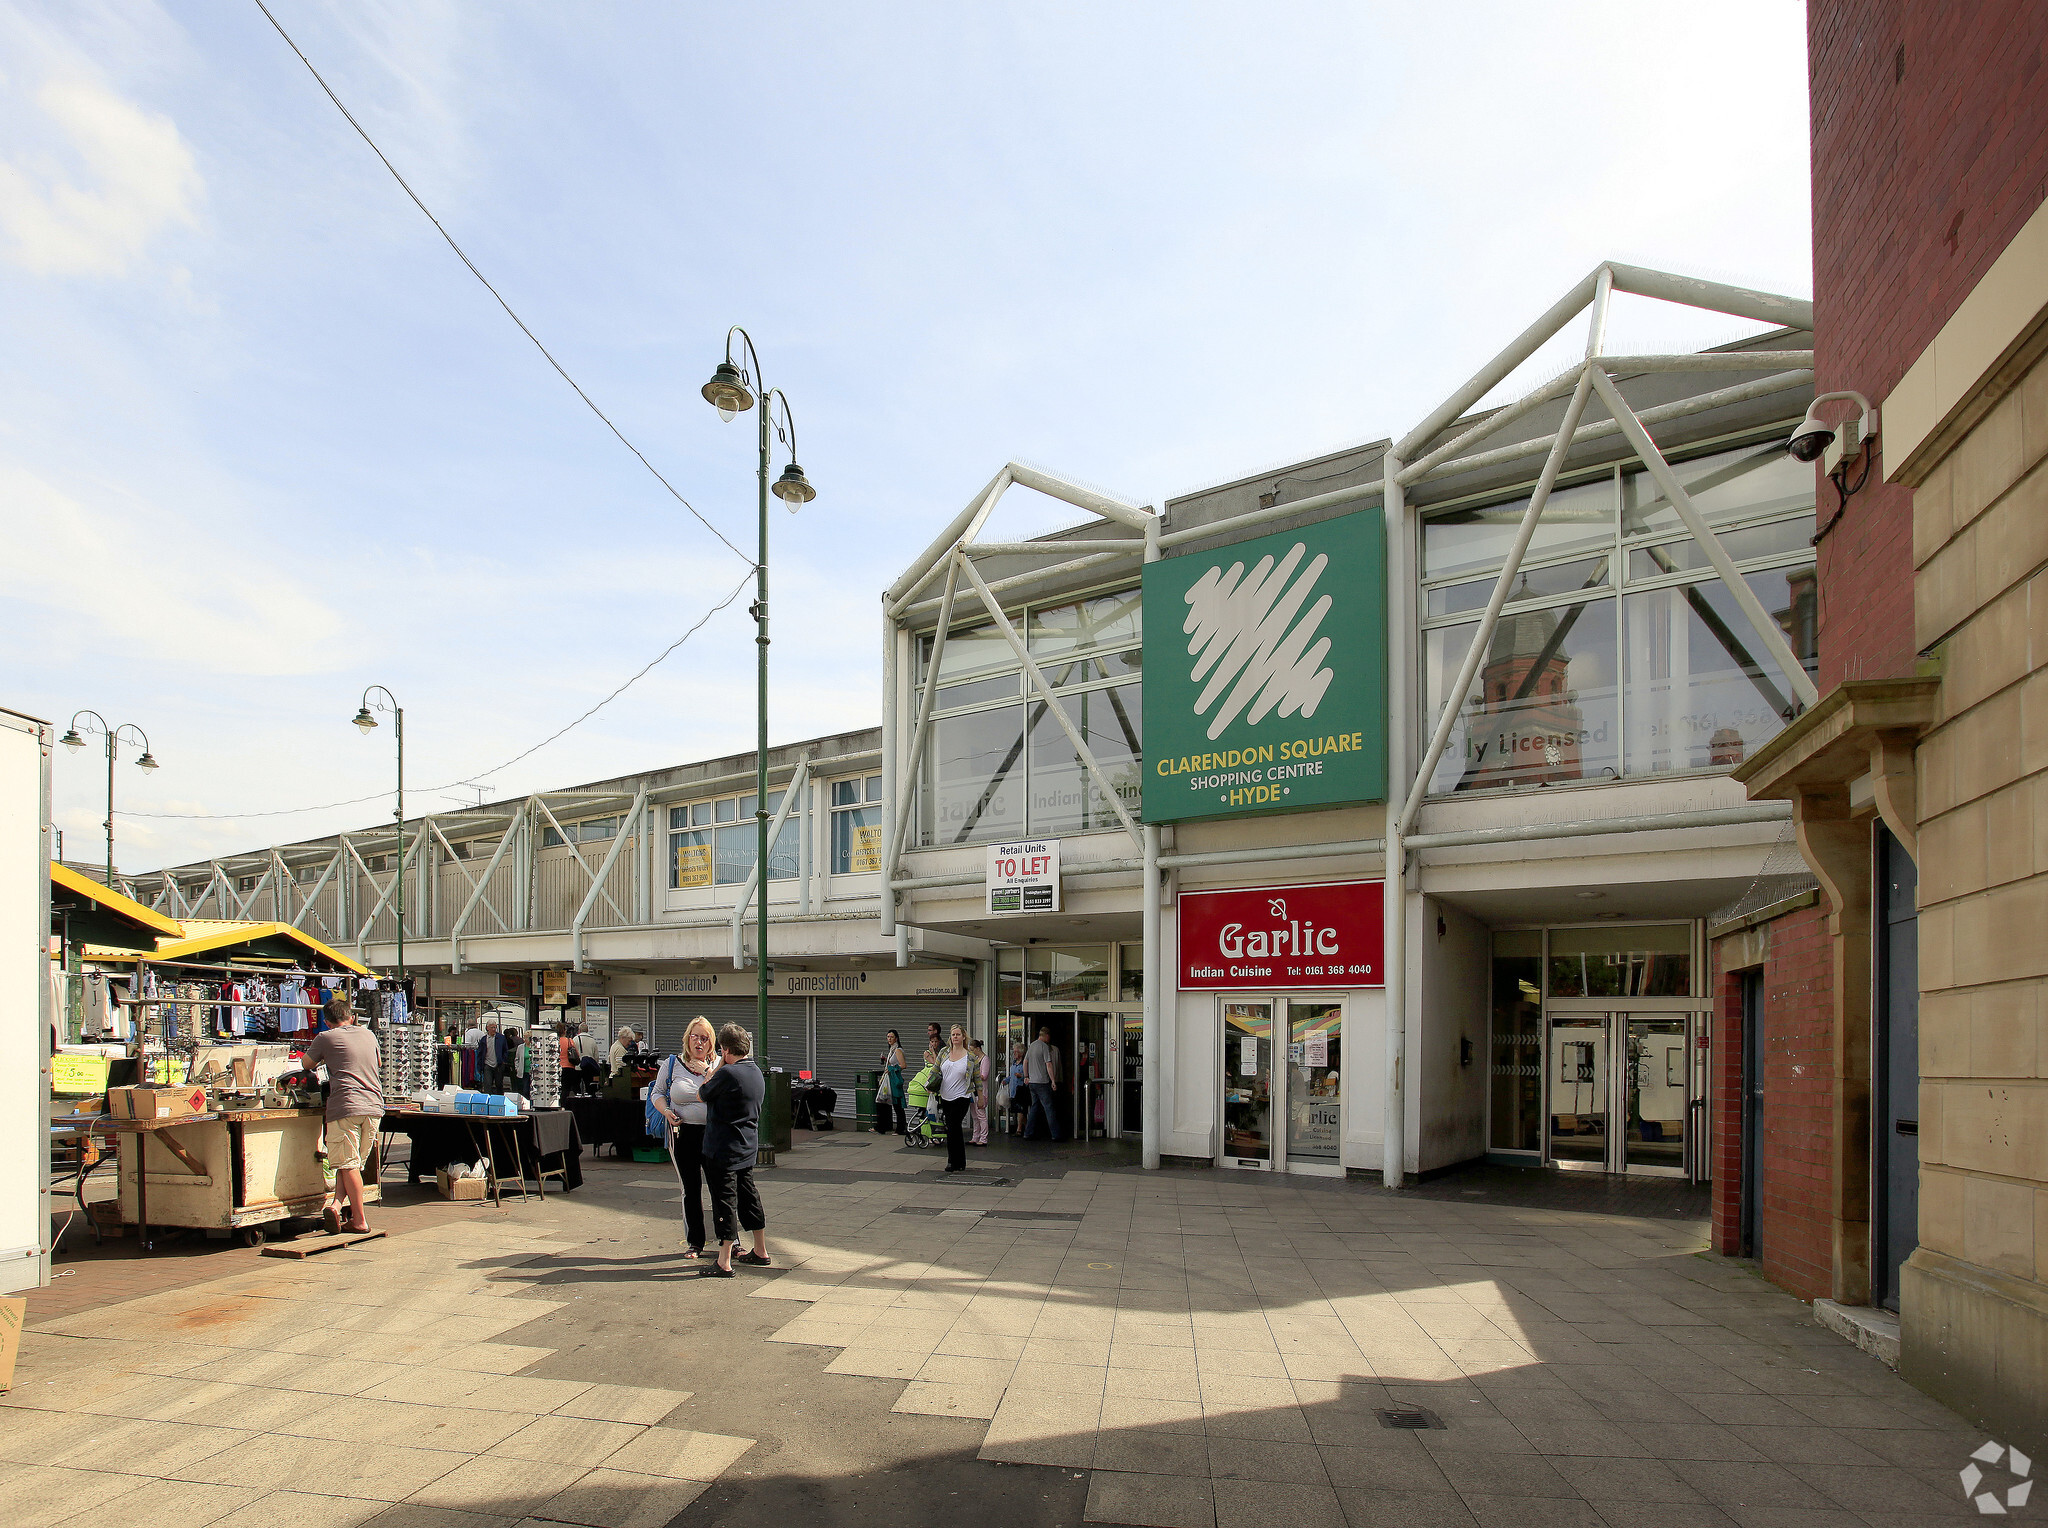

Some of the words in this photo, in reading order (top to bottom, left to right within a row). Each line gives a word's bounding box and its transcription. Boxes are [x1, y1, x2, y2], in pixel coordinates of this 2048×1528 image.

[1499, 720, 1608, 754] Licensed
[1157, 745, 1273, 776] CLARENDON
[1280, 732, 1362, 760] SQUARE
[1191, 769, 1262, 790] SHOPPING
[1267, 761, 1323, 780] CENTRE
[1033, 790, 1080, 809] Indian
[1230, 784, 1280, 806] HYDE
[860, 829, 881, 838] WALTO
[1000, 846, 1022, 855] Retail
[1025, 844, 1046, 853] Units
[995, 859, 1016, 877] TO
[1022, 856, 1051, 875] LET
[1219, 920, 1339, 959] Garlic
[1190, 966, 1224, 978] Indian
[1230, 965, 1272, 976] Cuisine
[1287, 966, 1301, 976] Tel:
[1305, 966, 1323, 975] 0161
[1328, 966, 1344, 974] 368
[1349, 965, 1371, 974] 4040
[655, 977, 712, 994] gamestation
[788, 973, 859, 994] gamestation
[916, 987, 957, 996] gamestation.co.uk
